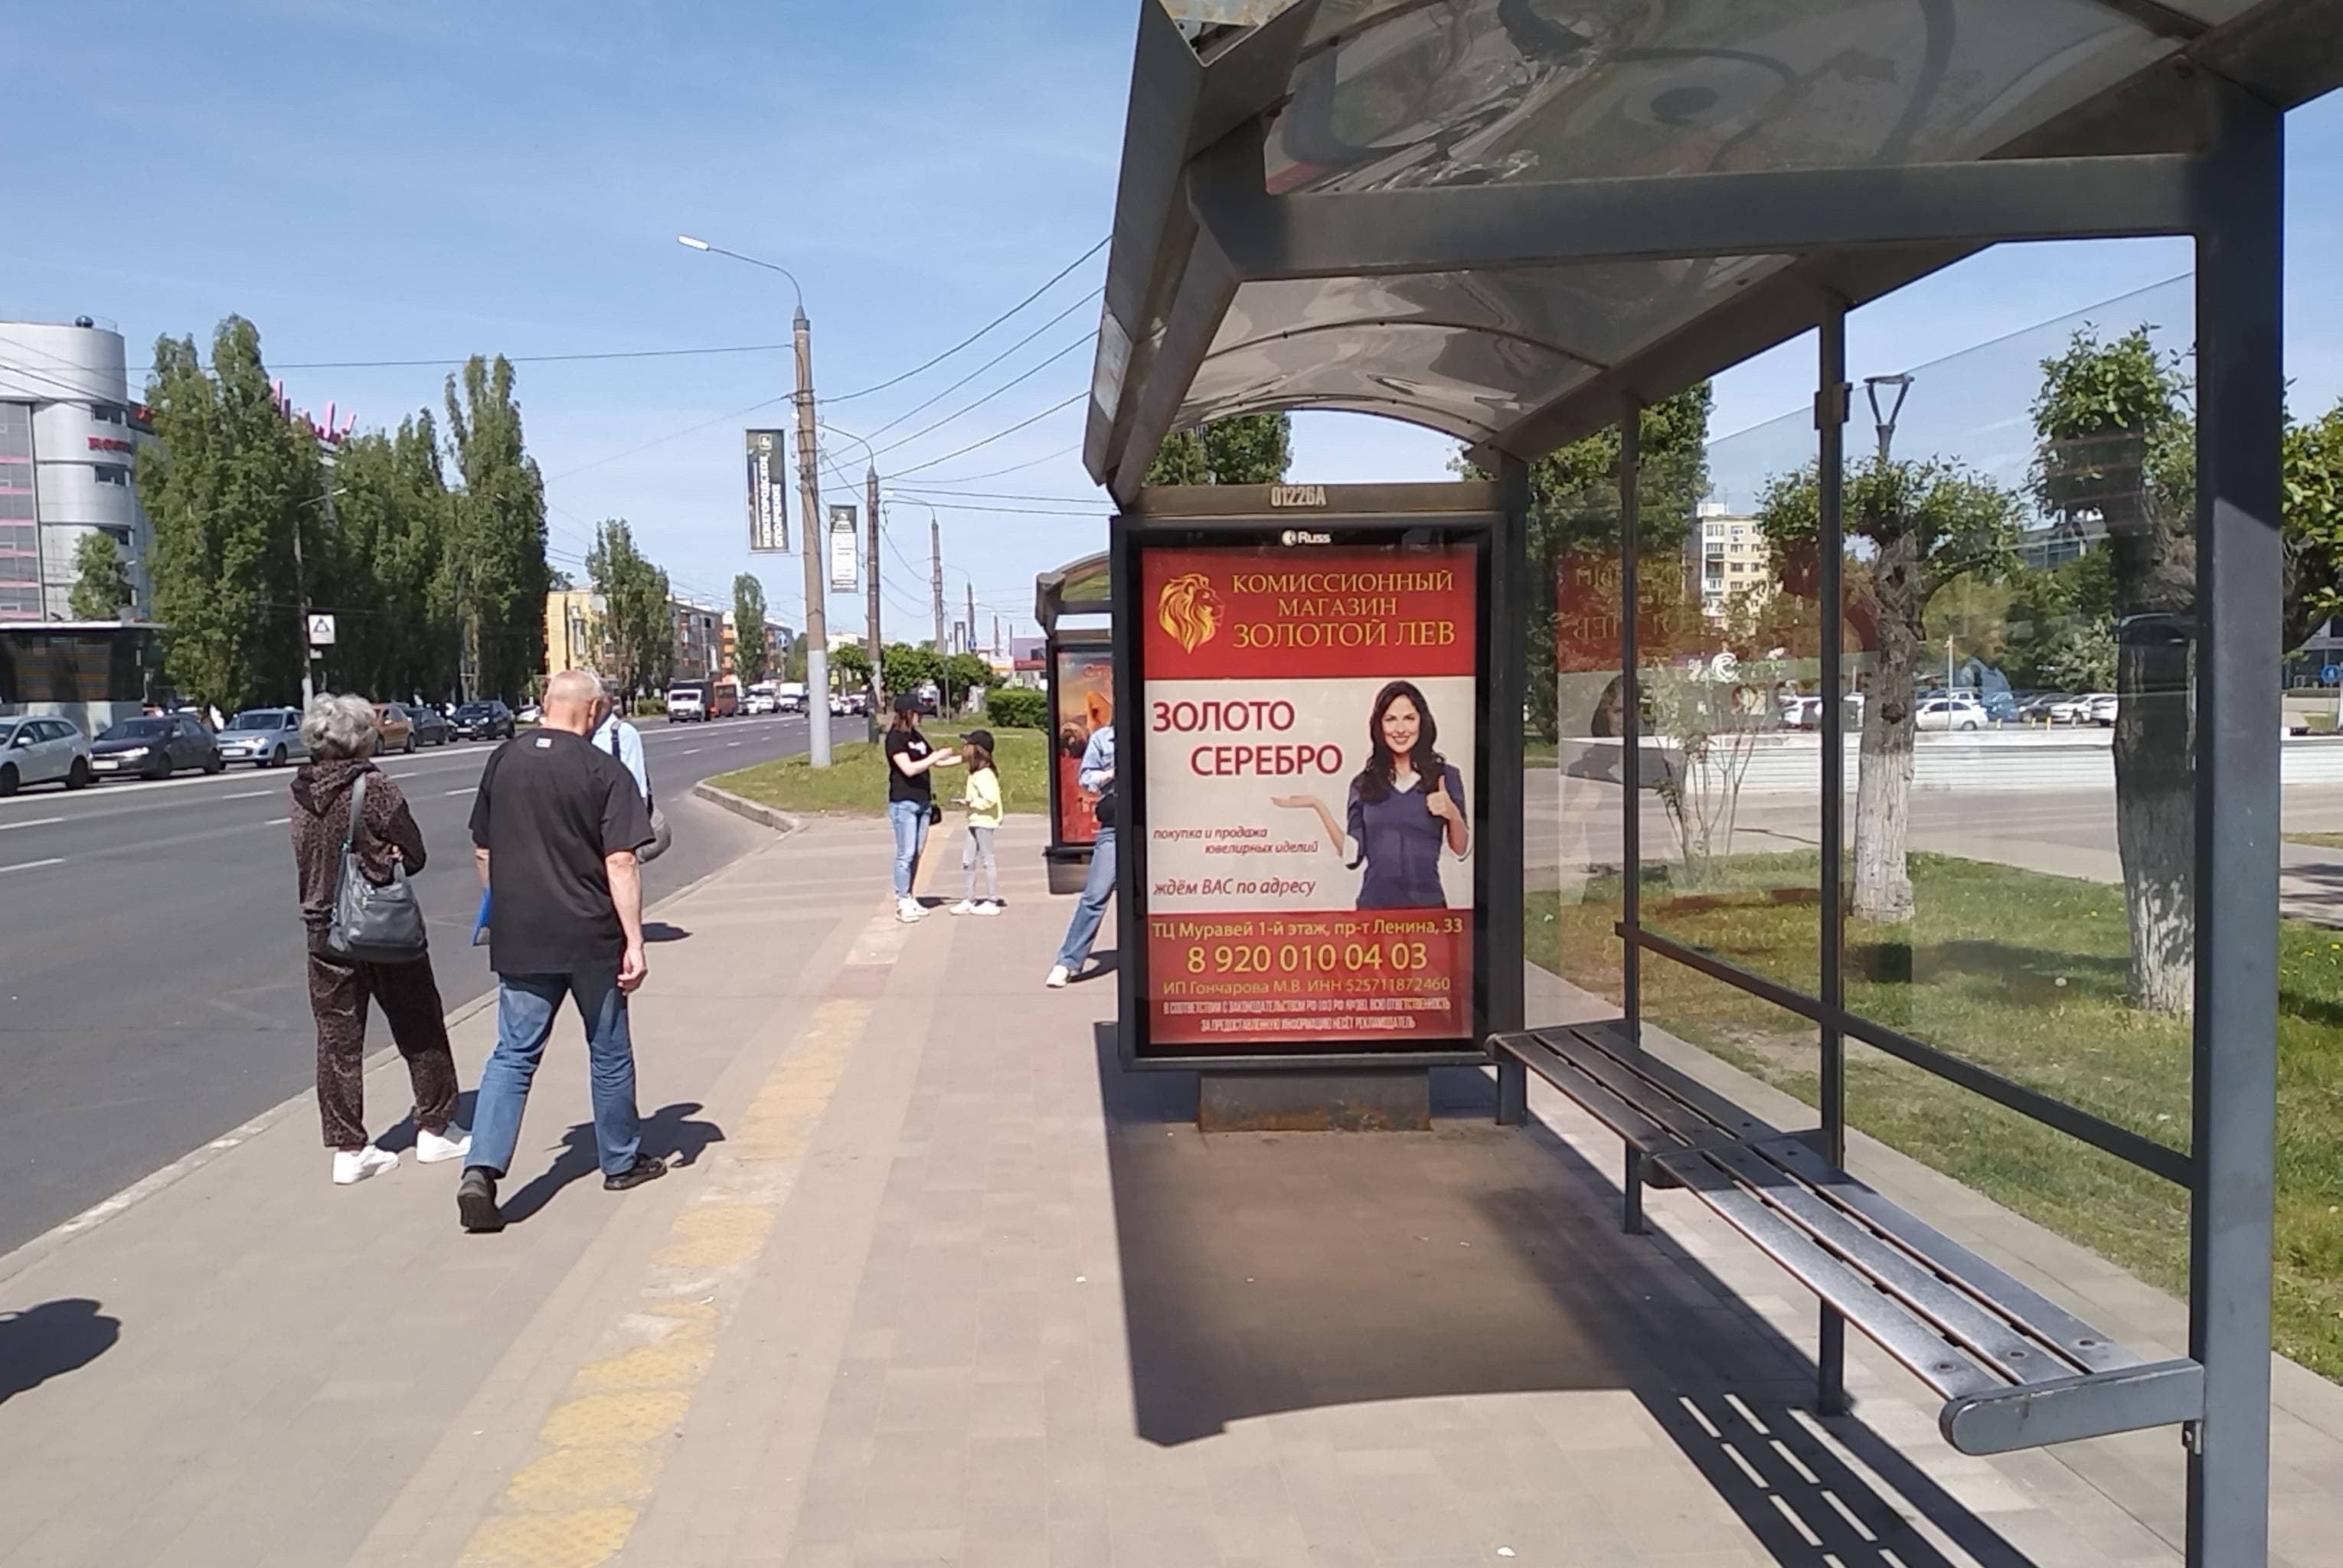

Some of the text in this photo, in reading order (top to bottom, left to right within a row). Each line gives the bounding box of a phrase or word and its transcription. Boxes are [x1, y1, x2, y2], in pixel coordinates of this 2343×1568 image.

[1298, 531, 1332, 544] Russ
[1232, 570, 1453, 593] КОМИССИОННЫЙ
[1278, 597, 1397, 616] МАГАЗИН
[1233, 619, 1455, 648] ЗОЛОТОЙ ЛЕВ
[1152, 701, 1295, 731] ЗОЛОТО
[1191, 743, 1342, 776] СЕРЕБРО
[1153, 826, 1268, 841] покупка и продажа
[1204, 843, 1273, 855] ювелирных
[1154, 877, 1316, 897] ждём ВАС по адресу
[1152, 918, 1463, 940] ТЦ Муравей 1-й этаж, пр-т Ленина, 33
[1188, 942, 1427, 973] 8 920 010 04 03
[1163, 981, 1186, 995] ИП
[1190, 981, 1269, 997] Гончарова
[1308, 979, 1341, 992] ИНН
